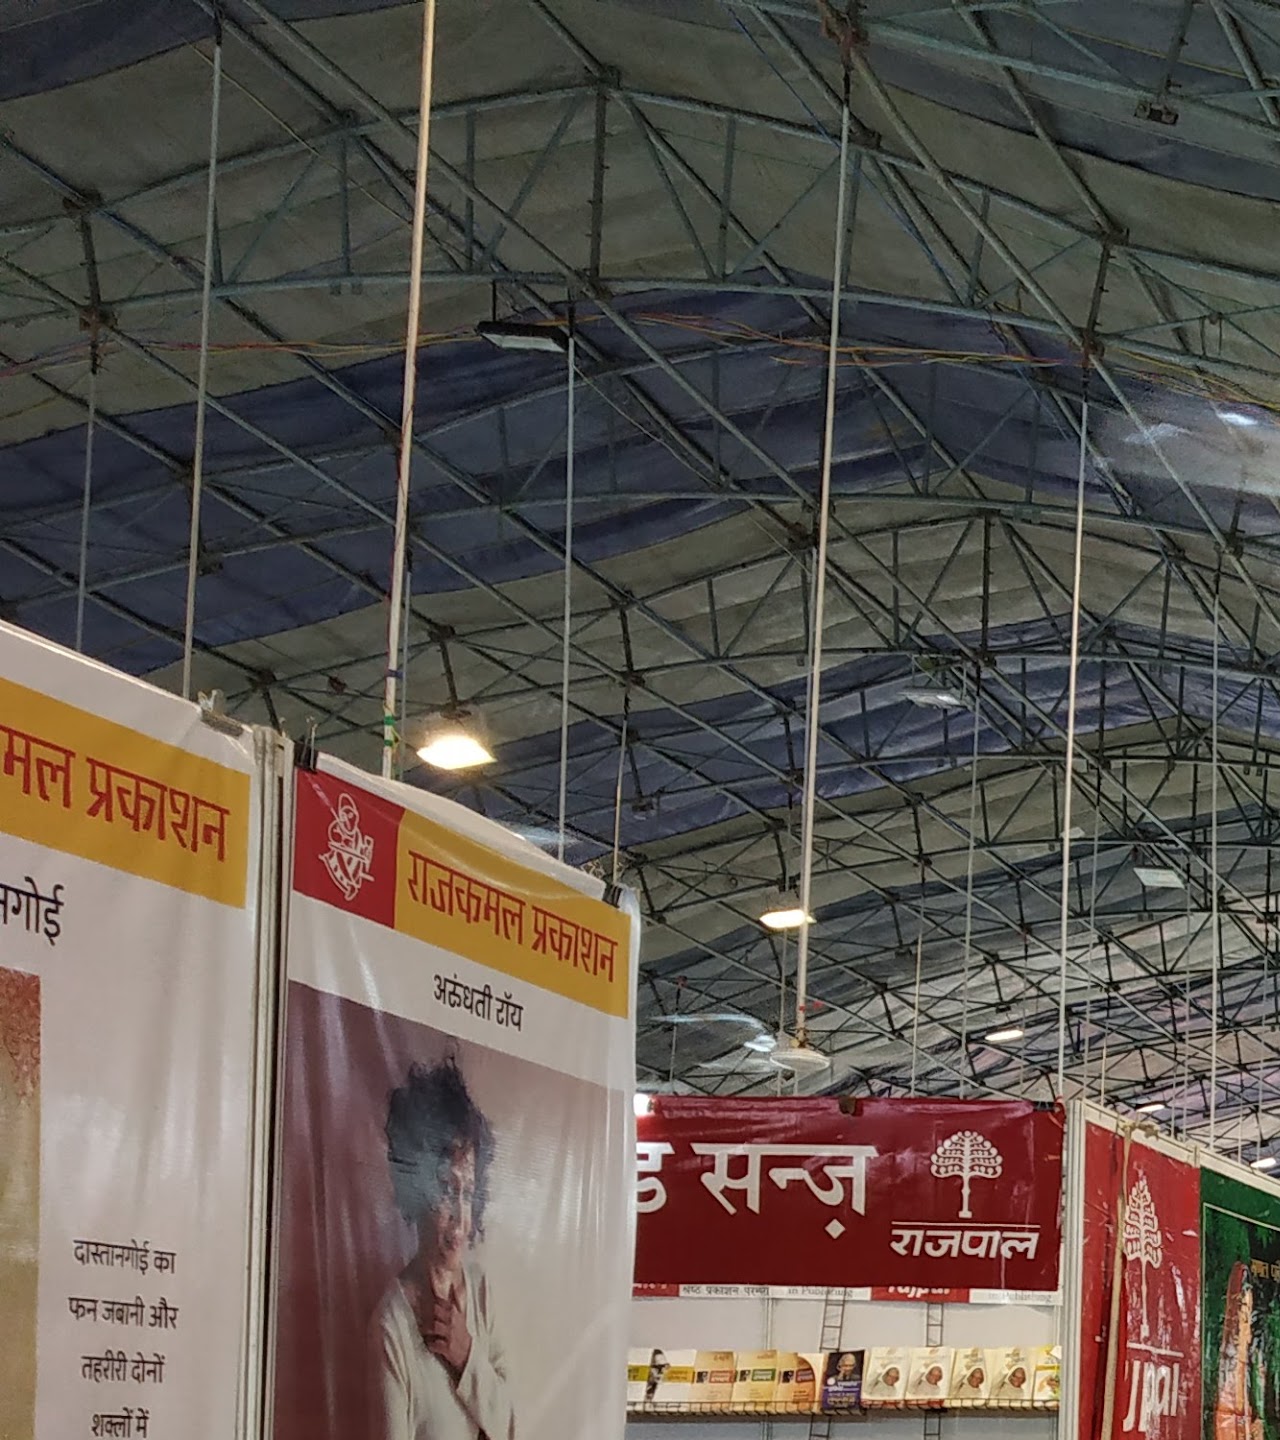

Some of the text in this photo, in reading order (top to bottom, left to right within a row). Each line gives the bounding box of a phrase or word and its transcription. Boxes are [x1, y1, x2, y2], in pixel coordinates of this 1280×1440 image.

[86, 757, 231, 862] प्रकाशन
[408, 850, 618, 982] राजकमल प्रकाशन
[495, 992, 525, 1032] रॉय
[73, 1239, 177, 1275] दास्तानगोई का
[889, 1226, 1041, 1260] राजपाल
[68, 1296, 179, 1329] फन जबानी और
[81, 1349, 165, 1384] तहरीरी दोनों
[91, 1407, 150, 1439] शक्लों में
